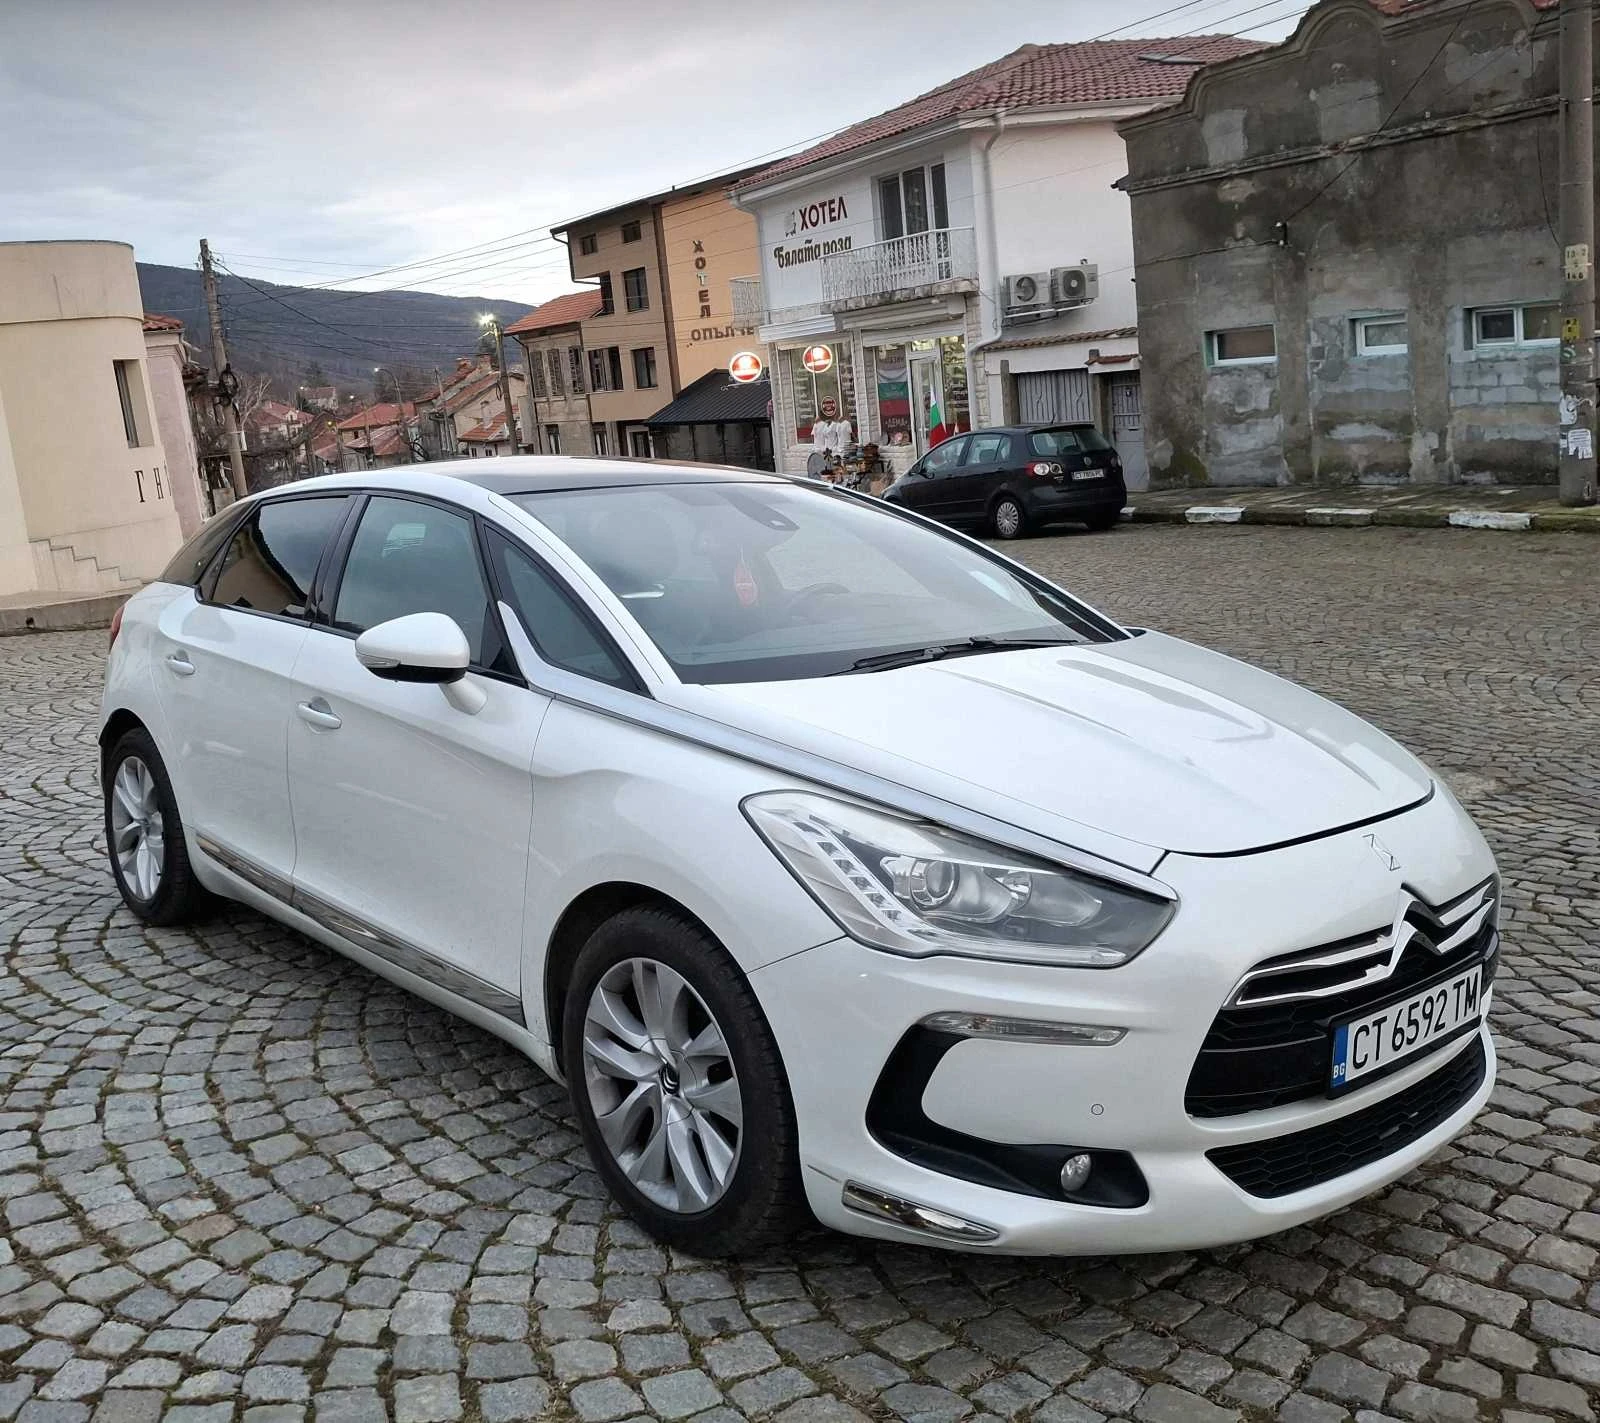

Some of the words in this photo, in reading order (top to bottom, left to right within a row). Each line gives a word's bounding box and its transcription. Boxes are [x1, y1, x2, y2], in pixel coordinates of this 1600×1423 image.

[799, 196, 848, 231] ХОТЕЛ
[773, 239, 821, 269] Бялата
[823, 236, 852, 261] роза
[692, 240, 711, 318] ХОТЕЛ
[1352, 1016, 1388, 1070] CT
[1391, 988, 1448, 1052] 6592
[1453, 972, 1479, 1022] TM
[1332, 1062, 1346, 1079] BG
